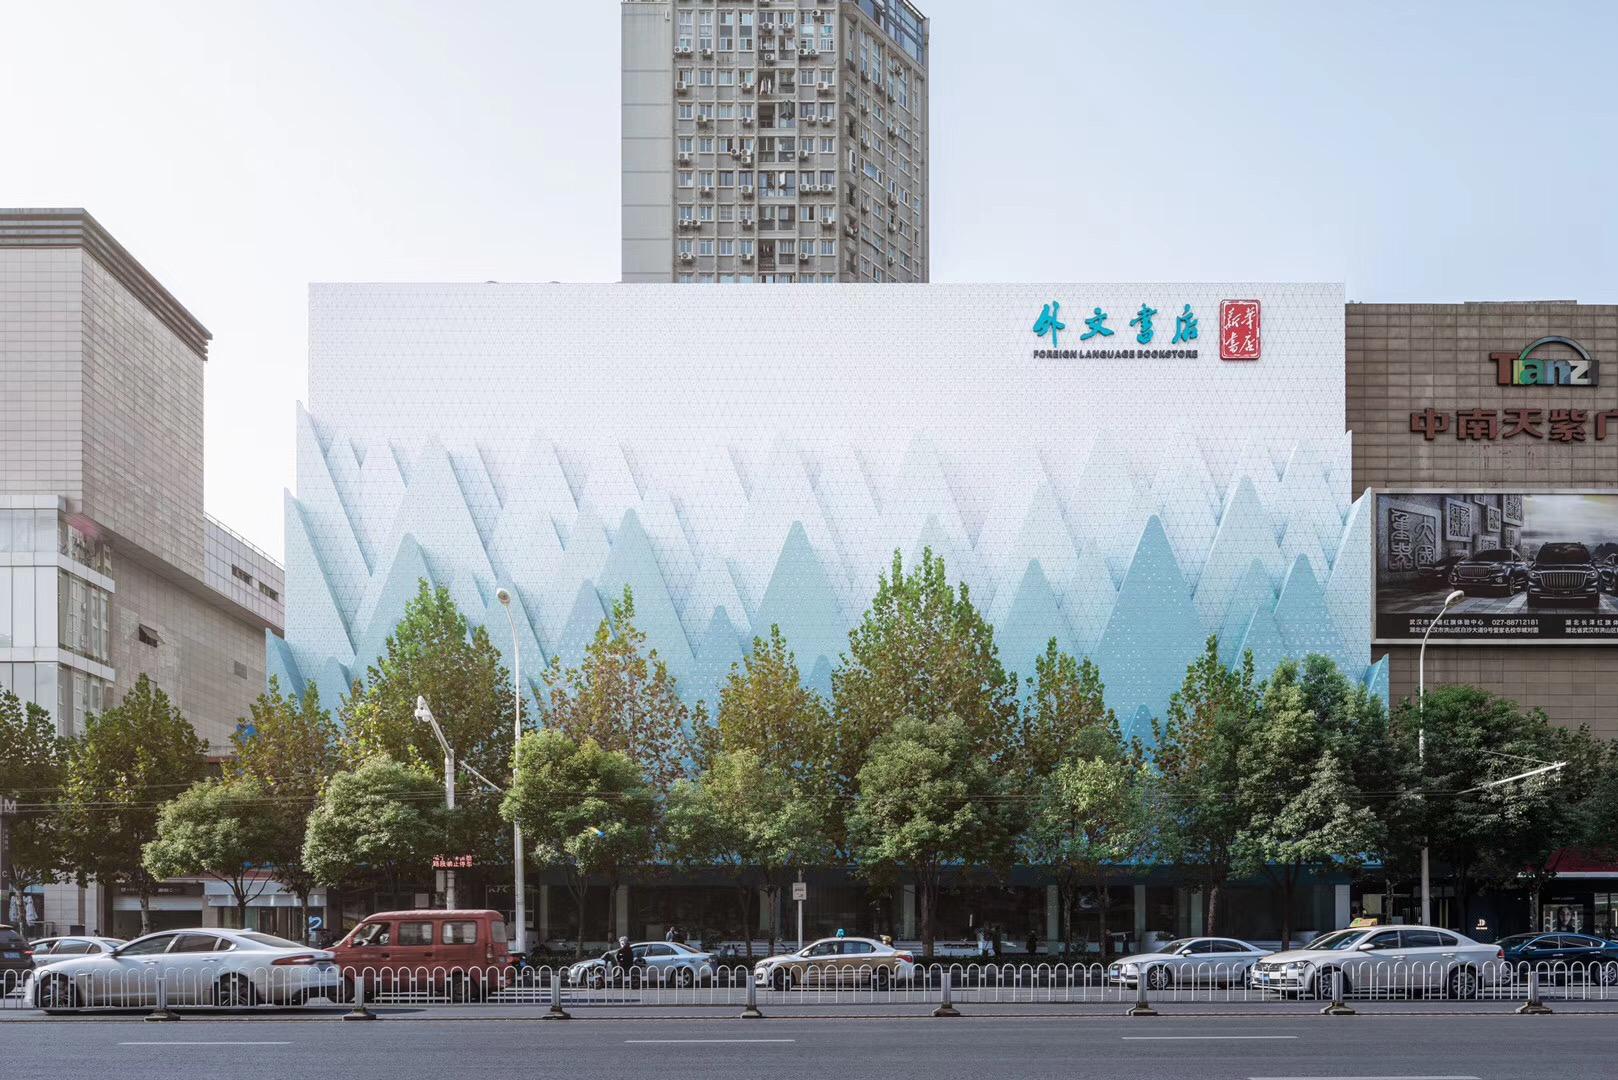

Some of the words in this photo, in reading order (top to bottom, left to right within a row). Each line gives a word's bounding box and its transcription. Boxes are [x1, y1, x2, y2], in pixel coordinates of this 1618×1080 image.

[1033, 349, 1078, 359] FOREIGN
[1079, 349, 1135, 359] LANGUAGE
[1137, 349, 1199, 359] BOOKSTORE
